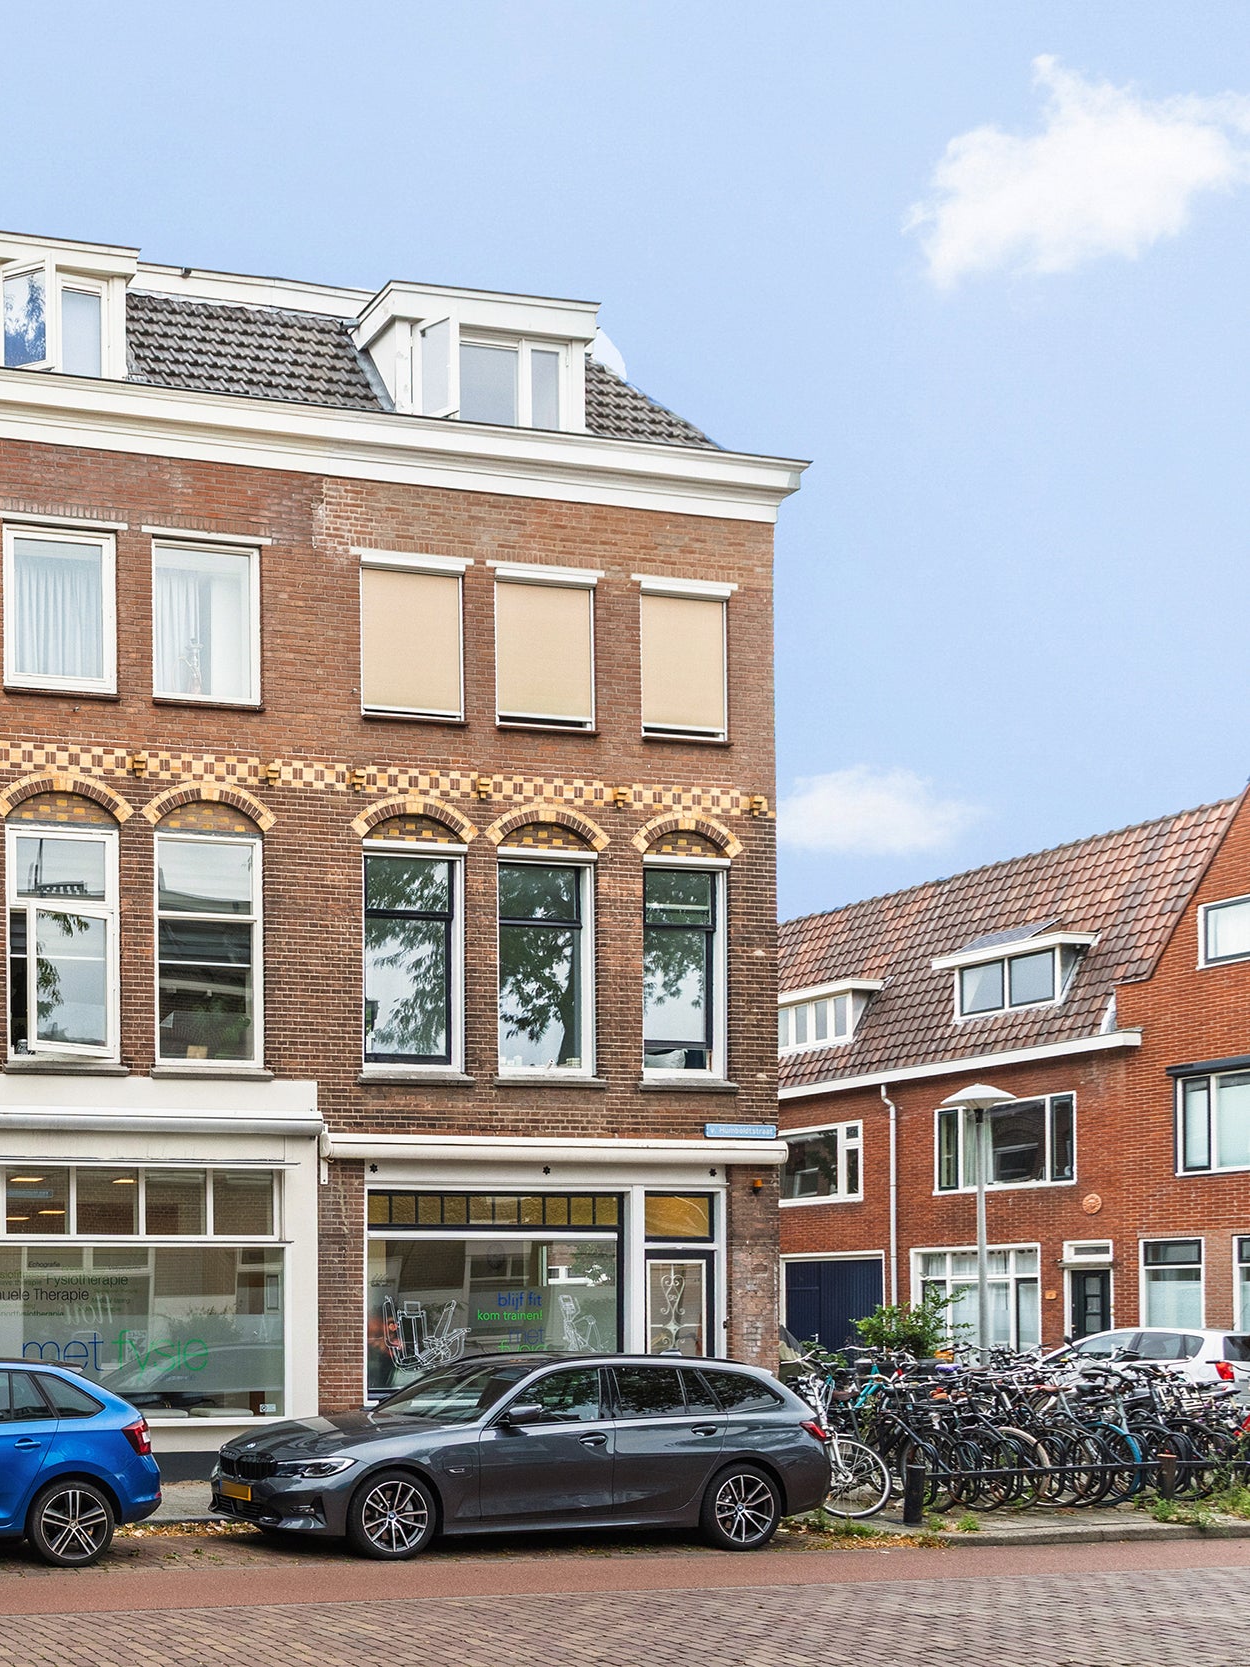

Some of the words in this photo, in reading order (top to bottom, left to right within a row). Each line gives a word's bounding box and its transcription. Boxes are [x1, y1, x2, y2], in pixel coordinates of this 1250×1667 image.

[46, 1273, 129, 1287] Fysiotherapie
[33, 1287, 90, 1303] Therapie
[497, 1291, 524, 1310] blijf
[528, 1291, 542, 1307] fit
[477, 1309, 501, 1321] kom
[503, 1310, 543, 1321] trainen!
[508, 1325, 546, 1345] met
[22, 1332, 104, 1371] met
[111, 1329, 210, 1381] fysie
